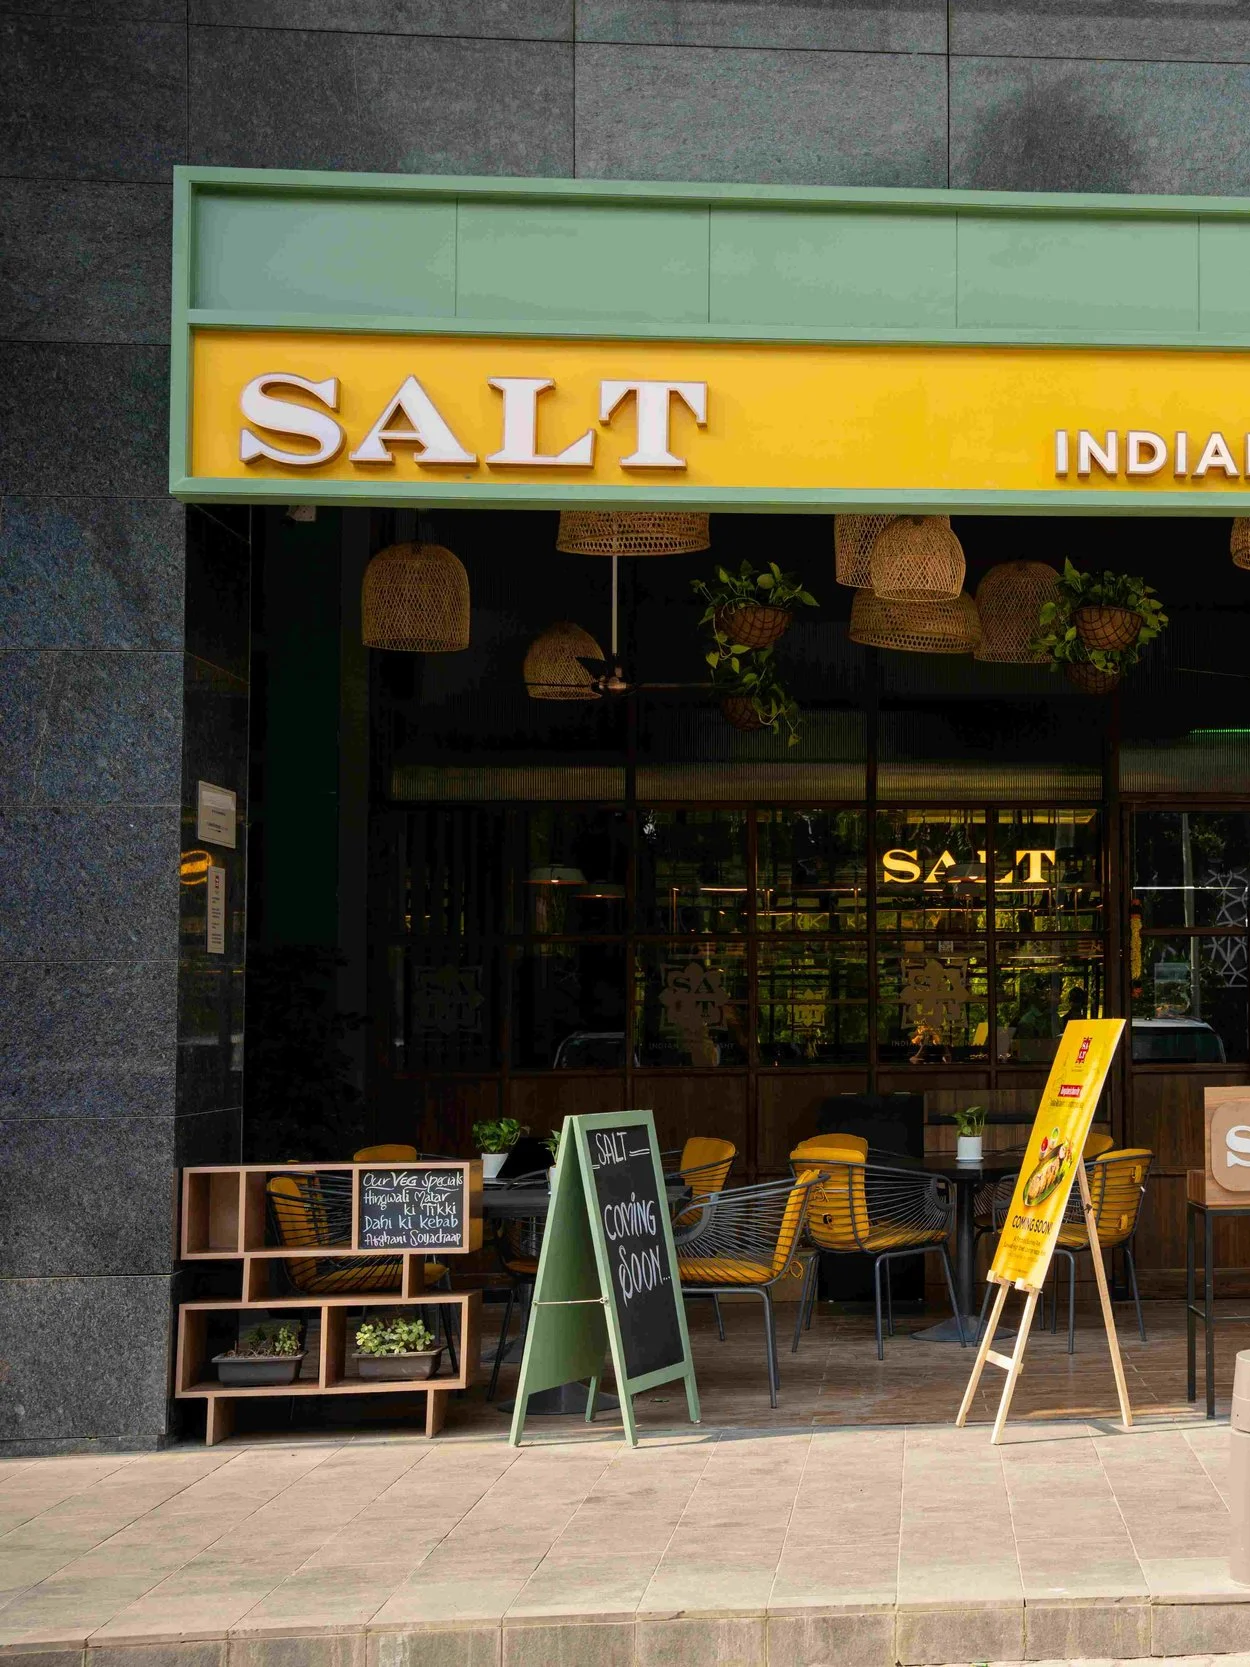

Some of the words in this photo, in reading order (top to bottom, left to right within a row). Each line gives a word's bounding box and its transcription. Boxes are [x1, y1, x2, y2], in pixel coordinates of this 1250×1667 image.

[238, 371, 708, 470] SALT
[595, 1131, 628, 1166] SALT
[363, 1172, 391, 1187] Our
[421, 1171, 464, 1193] Specials
[363, 1189, 410, 1211] Hingwali
[414, 1190, 451, 1207] Matar
[404, 1203, 416, 1216] ki
[421, 1201, 457, 1216] Tikki
[363, 1214, 393, 1232] Dahi
[1012, 1215, 1035, 1231] COMING
[364, 1231, 407, 1247] Afghani
